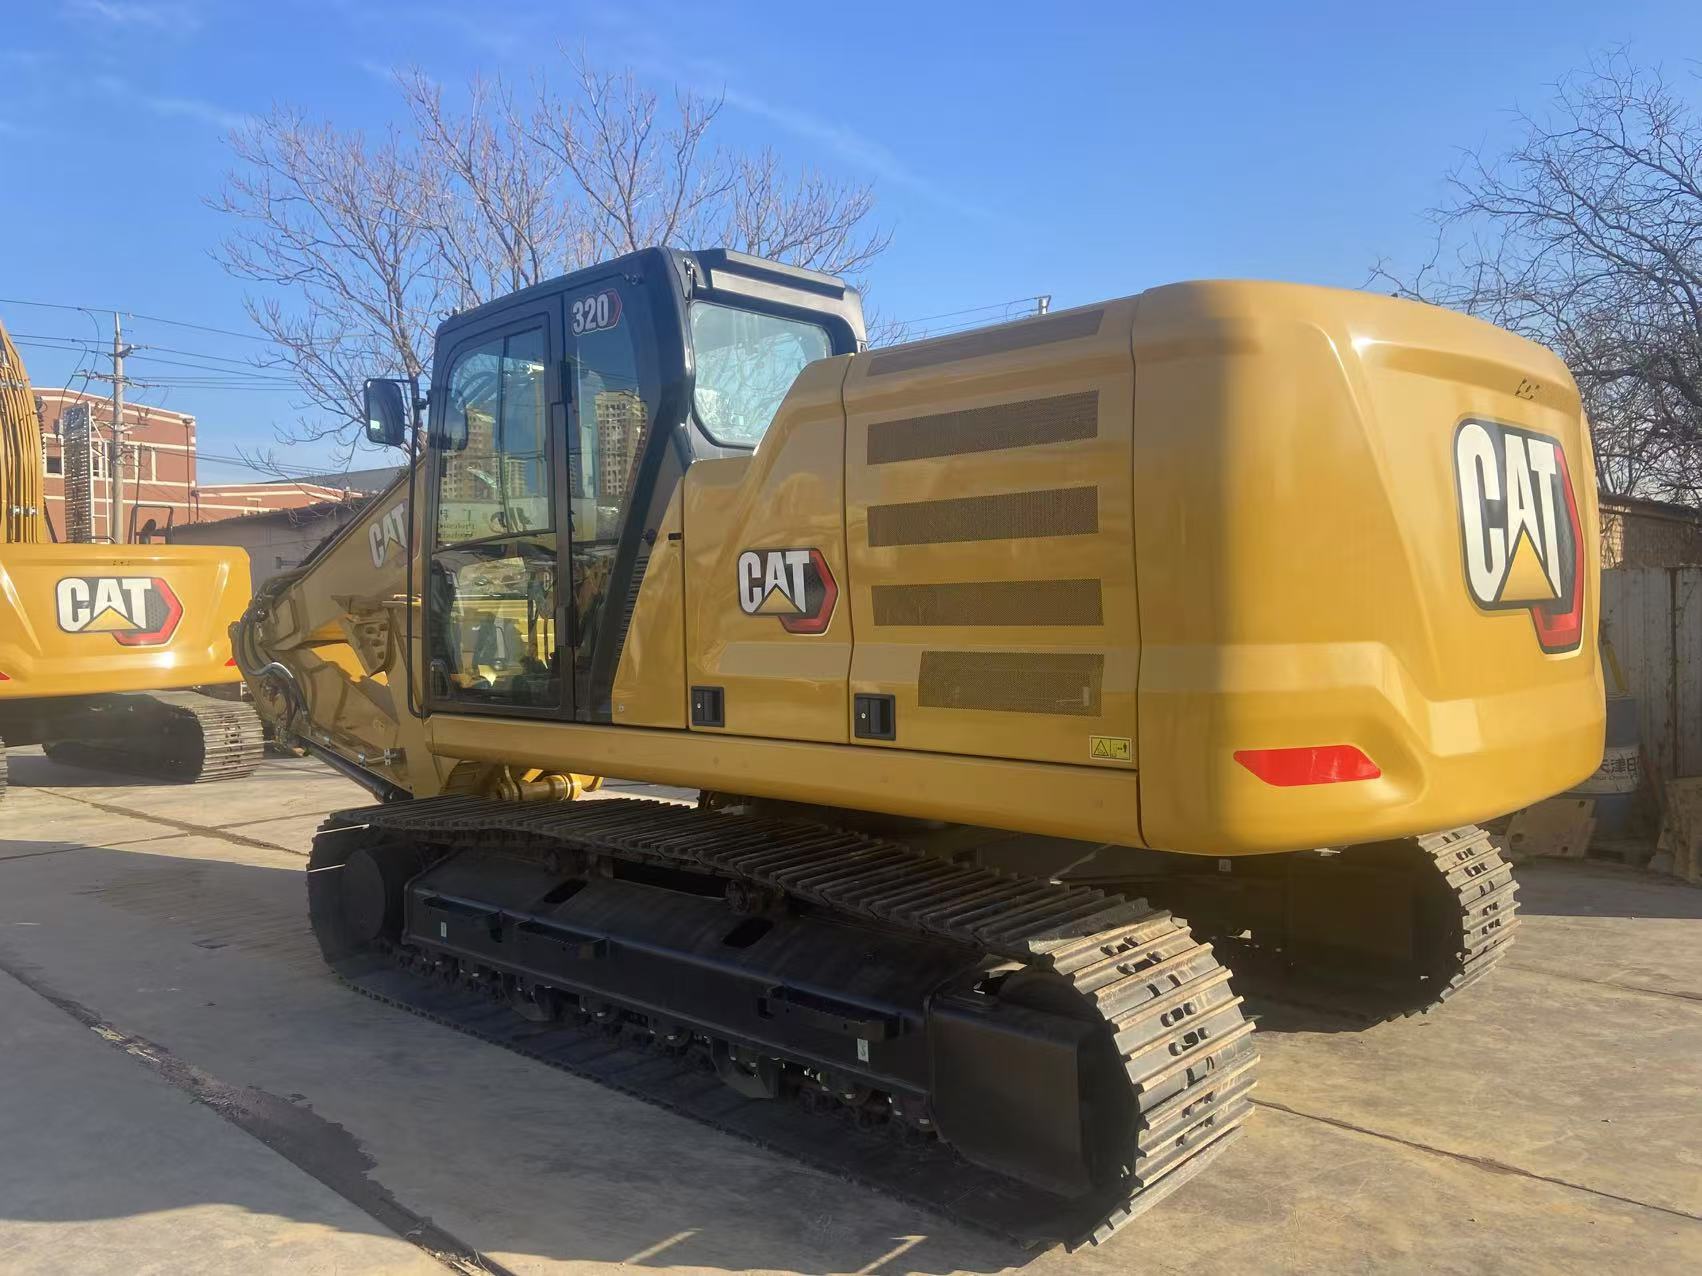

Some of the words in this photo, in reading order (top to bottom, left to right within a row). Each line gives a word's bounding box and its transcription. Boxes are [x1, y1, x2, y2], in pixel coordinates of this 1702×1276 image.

[573, 294, 609, 333] 320
[369, 503, 408, 568] CAT
[1457, 423, 1562, 602] CAT
[57, 578, 152, 632] CAT
[738, 550, 810, 613] CAT
